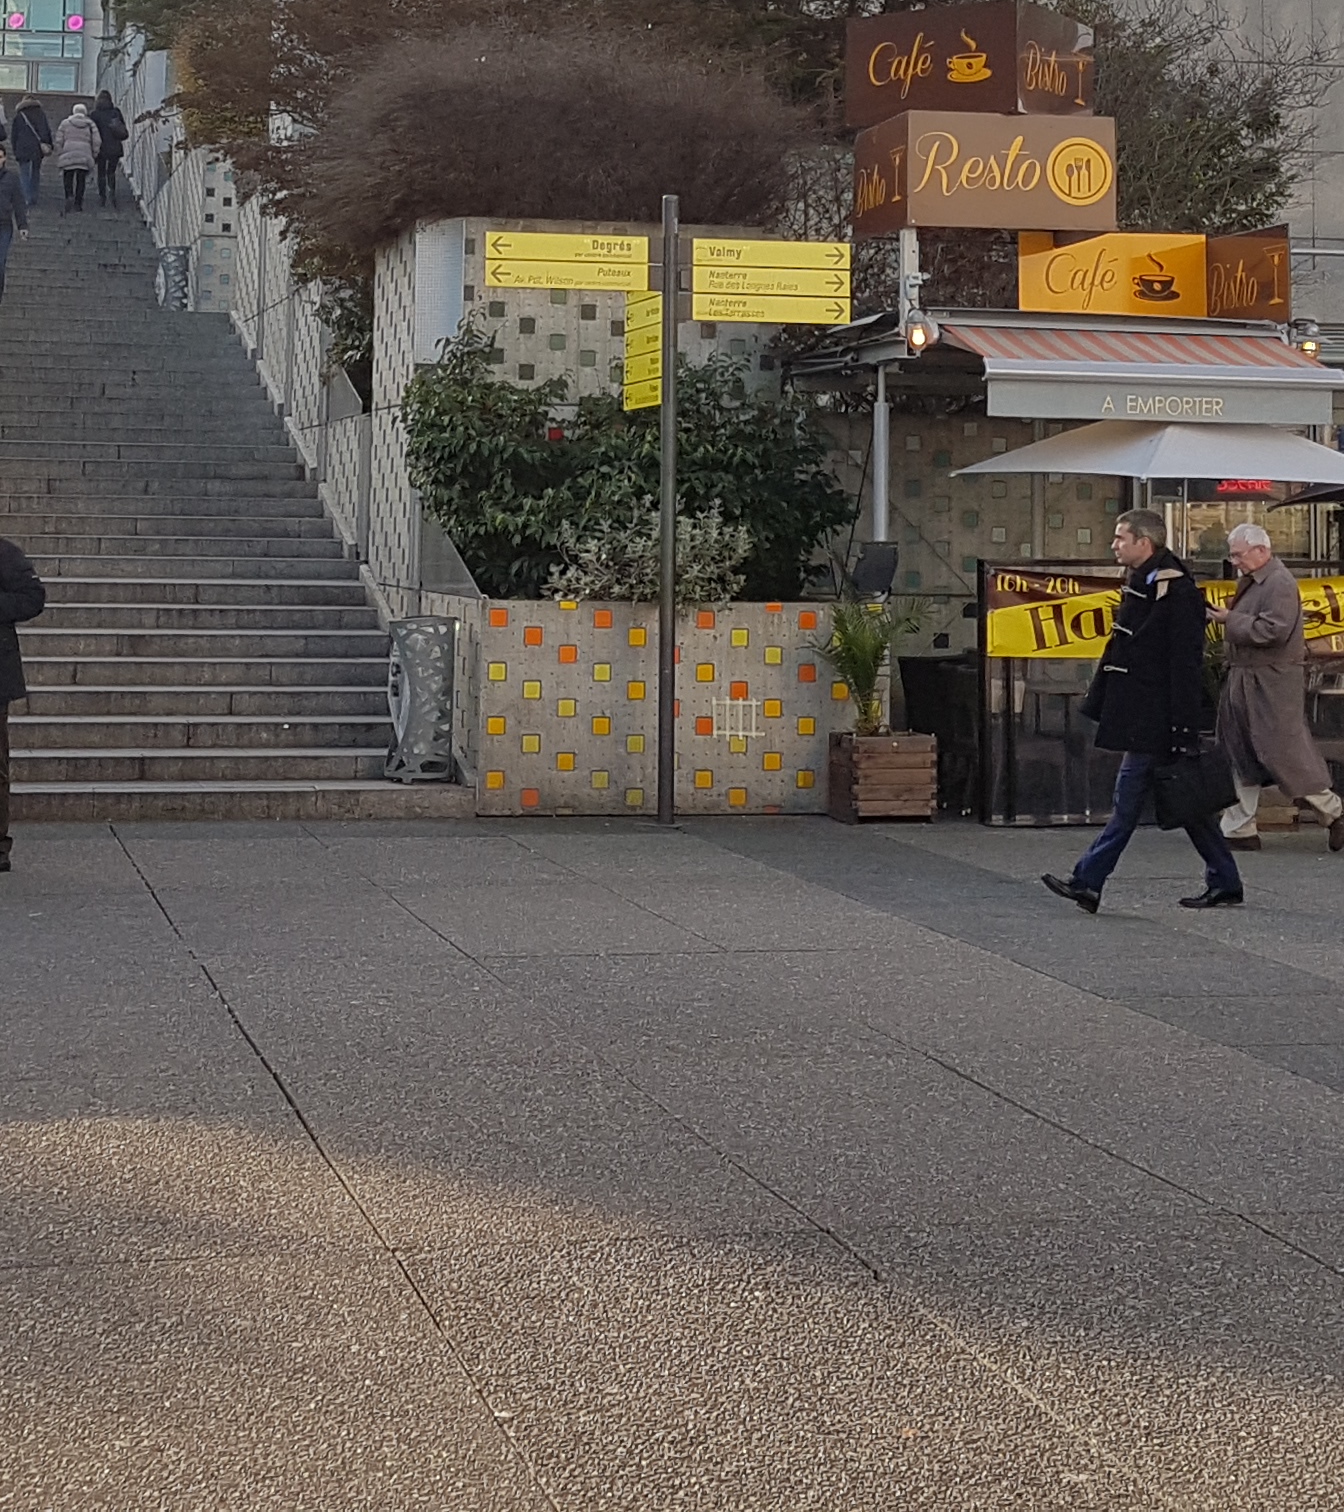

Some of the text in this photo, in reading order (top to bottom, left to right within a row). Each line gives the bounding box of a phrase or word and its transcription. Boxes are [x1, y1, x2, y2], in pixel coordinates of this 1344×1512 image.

[867, 32, 934, 100] Café
[1024, 40, 1068, 98] Bistro
[913, 130, 1043, 198] Resto
[591, 239, 633, 254] Degrés
[708, 246, 743, 261] Valmy
[596, 267, 632, 278] Puteaux
[708, 270, 748, 280] Nanterre
[1044, 248, 1118, 310] Café
[1209, 262, 1258, 316] Bistro
[708, 297, 748, 308] Nanterre
[1101, 394, 1224, 418] A EMPORTER
[995, 574, 1029, 593] 16h
[1044, 575, 1081, 595] 20h
[1024, 601, 1115, 652] Ha
